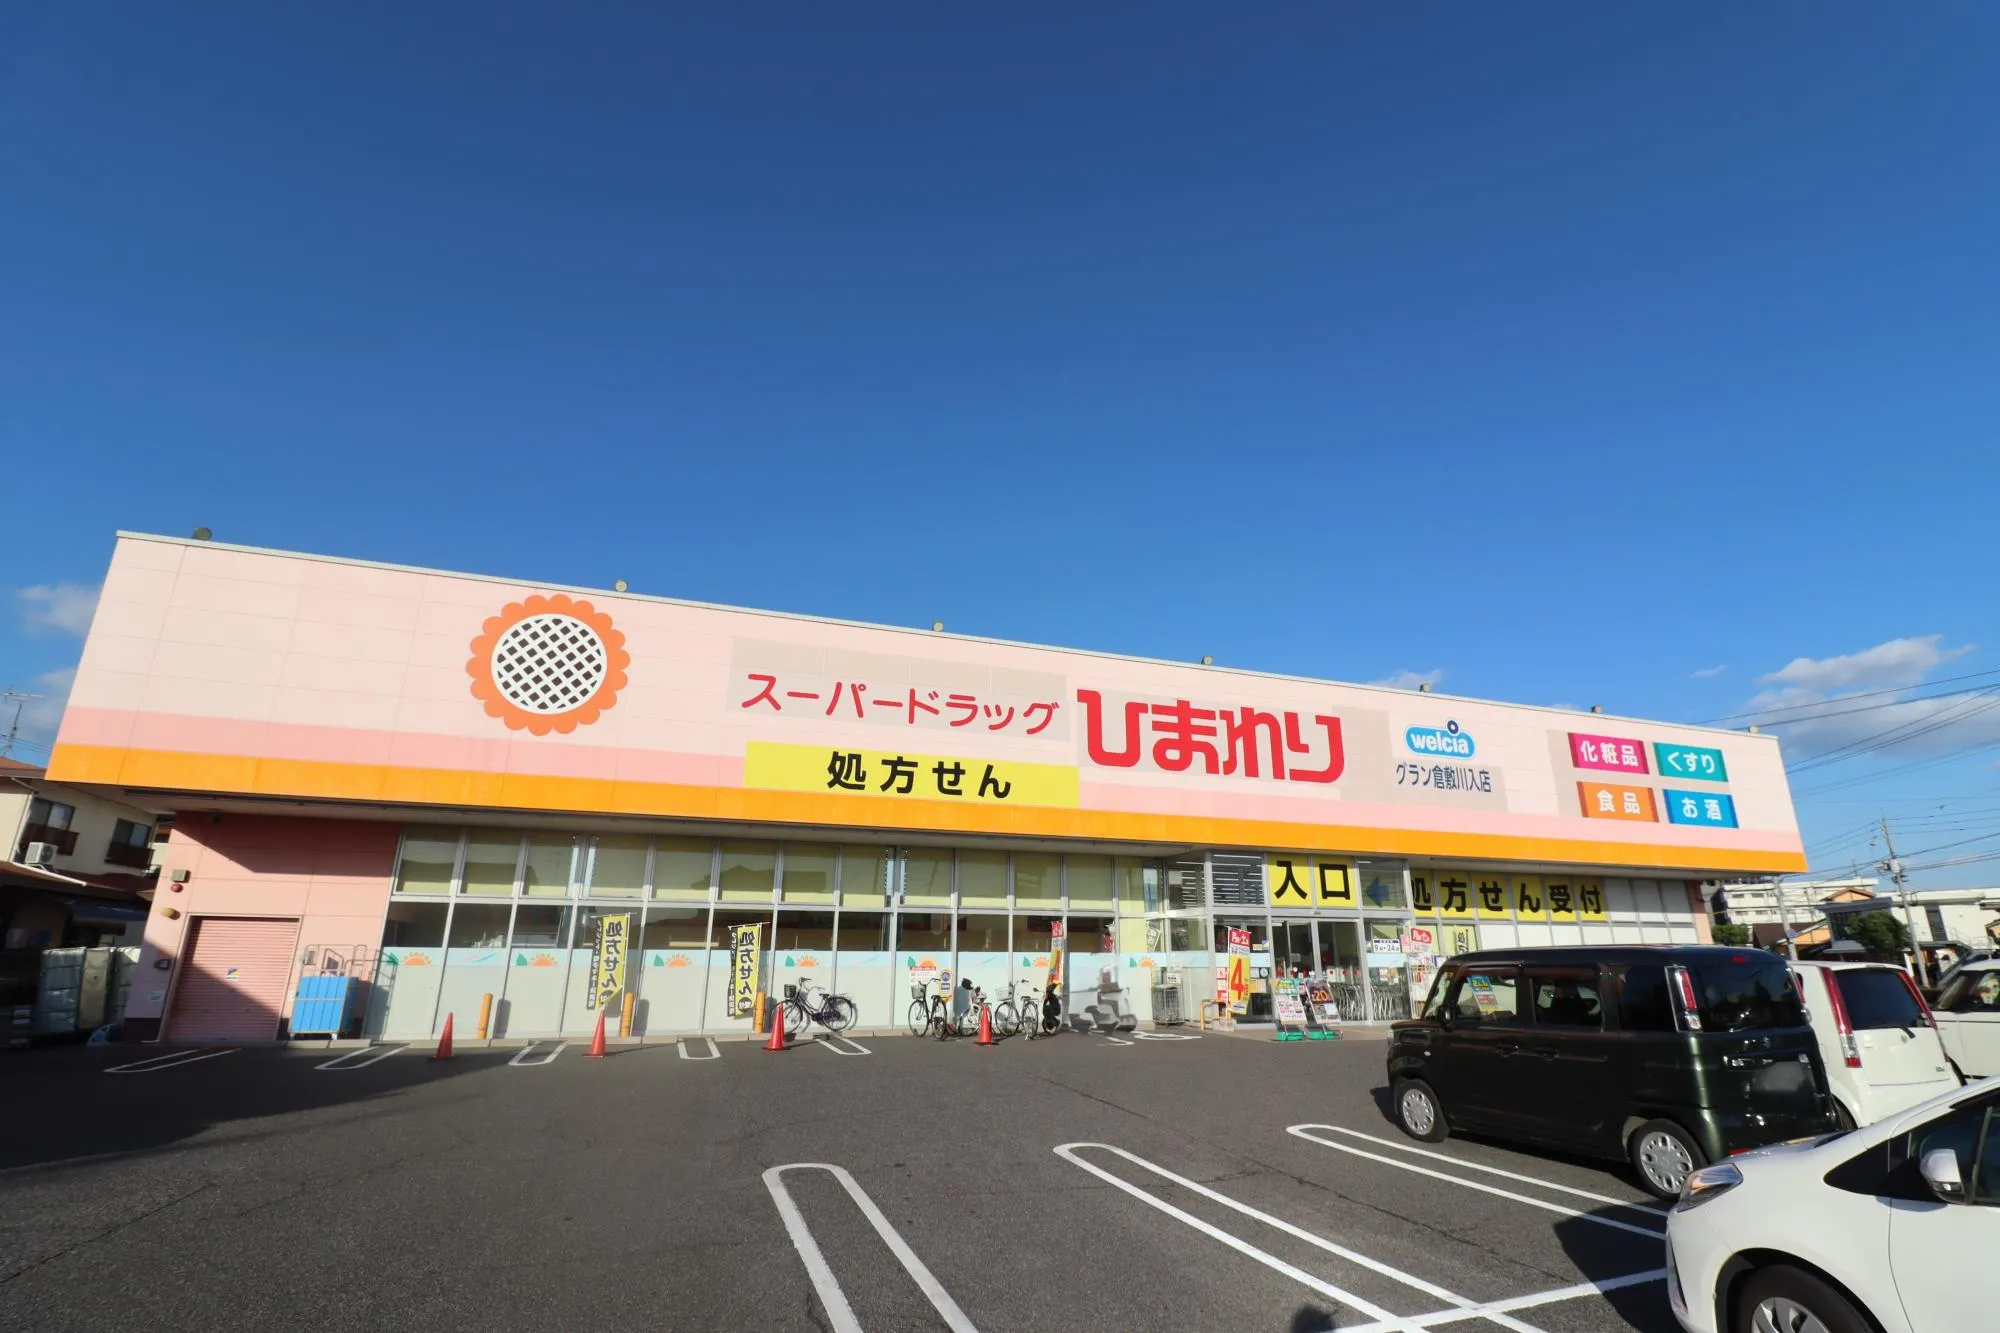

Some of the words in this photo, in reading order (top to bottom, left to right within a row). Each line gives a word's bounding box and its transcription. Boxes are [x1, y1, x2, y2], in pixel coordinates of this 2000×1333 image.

[741, 673, 1060, 735] スーパードラッグ
[1076, 688, 1345, 784] ひまわり
[1409, 720, 1470, 755] welcia
[1580, 740, 1639, 767] 化粧品
[827, 750, 1012, 799] 処方せん
[1395, 761, 1492, 793] グラン倉敷川入店
[1667, 751, 1716, 774] くすり
[1597, 789, 1641, 815] 食品
[1681, 797, 1723, 821] お酒
[1274, 860, 1350, 900] 入口
[1411, 876, 1602, 914] 処方せん受付
